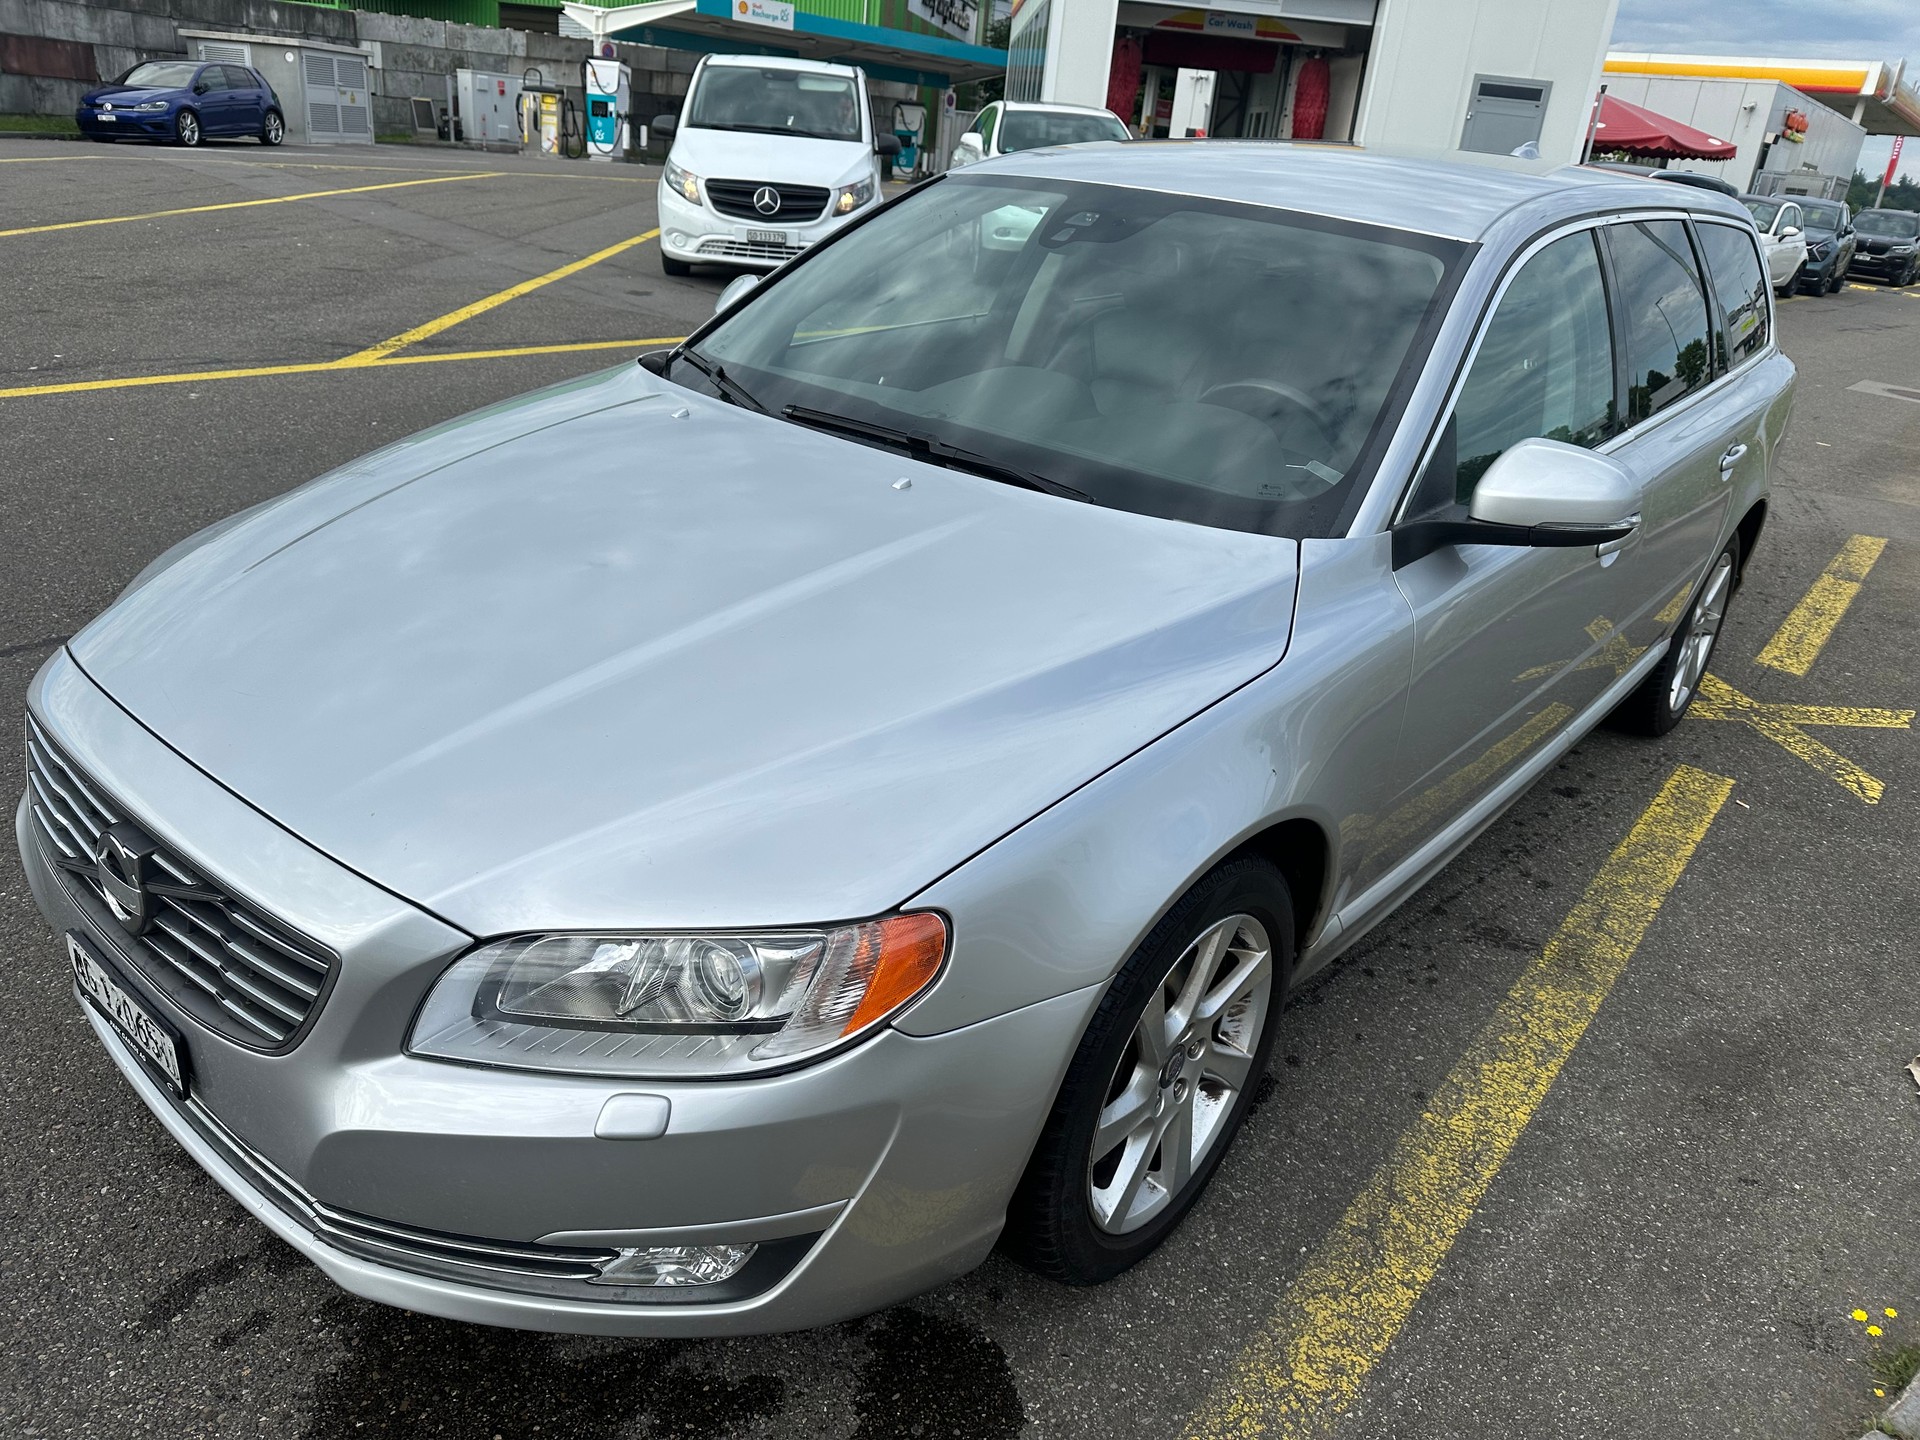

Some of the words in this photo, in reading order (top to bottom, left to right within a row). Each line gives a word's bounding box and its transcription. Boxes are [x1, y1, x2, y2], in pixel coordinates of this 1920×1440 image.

[752, 9, 779, 21] Recharge
[1208, 17, 1224, 27] Car
[1227, 20, 1253, 30] Wash
